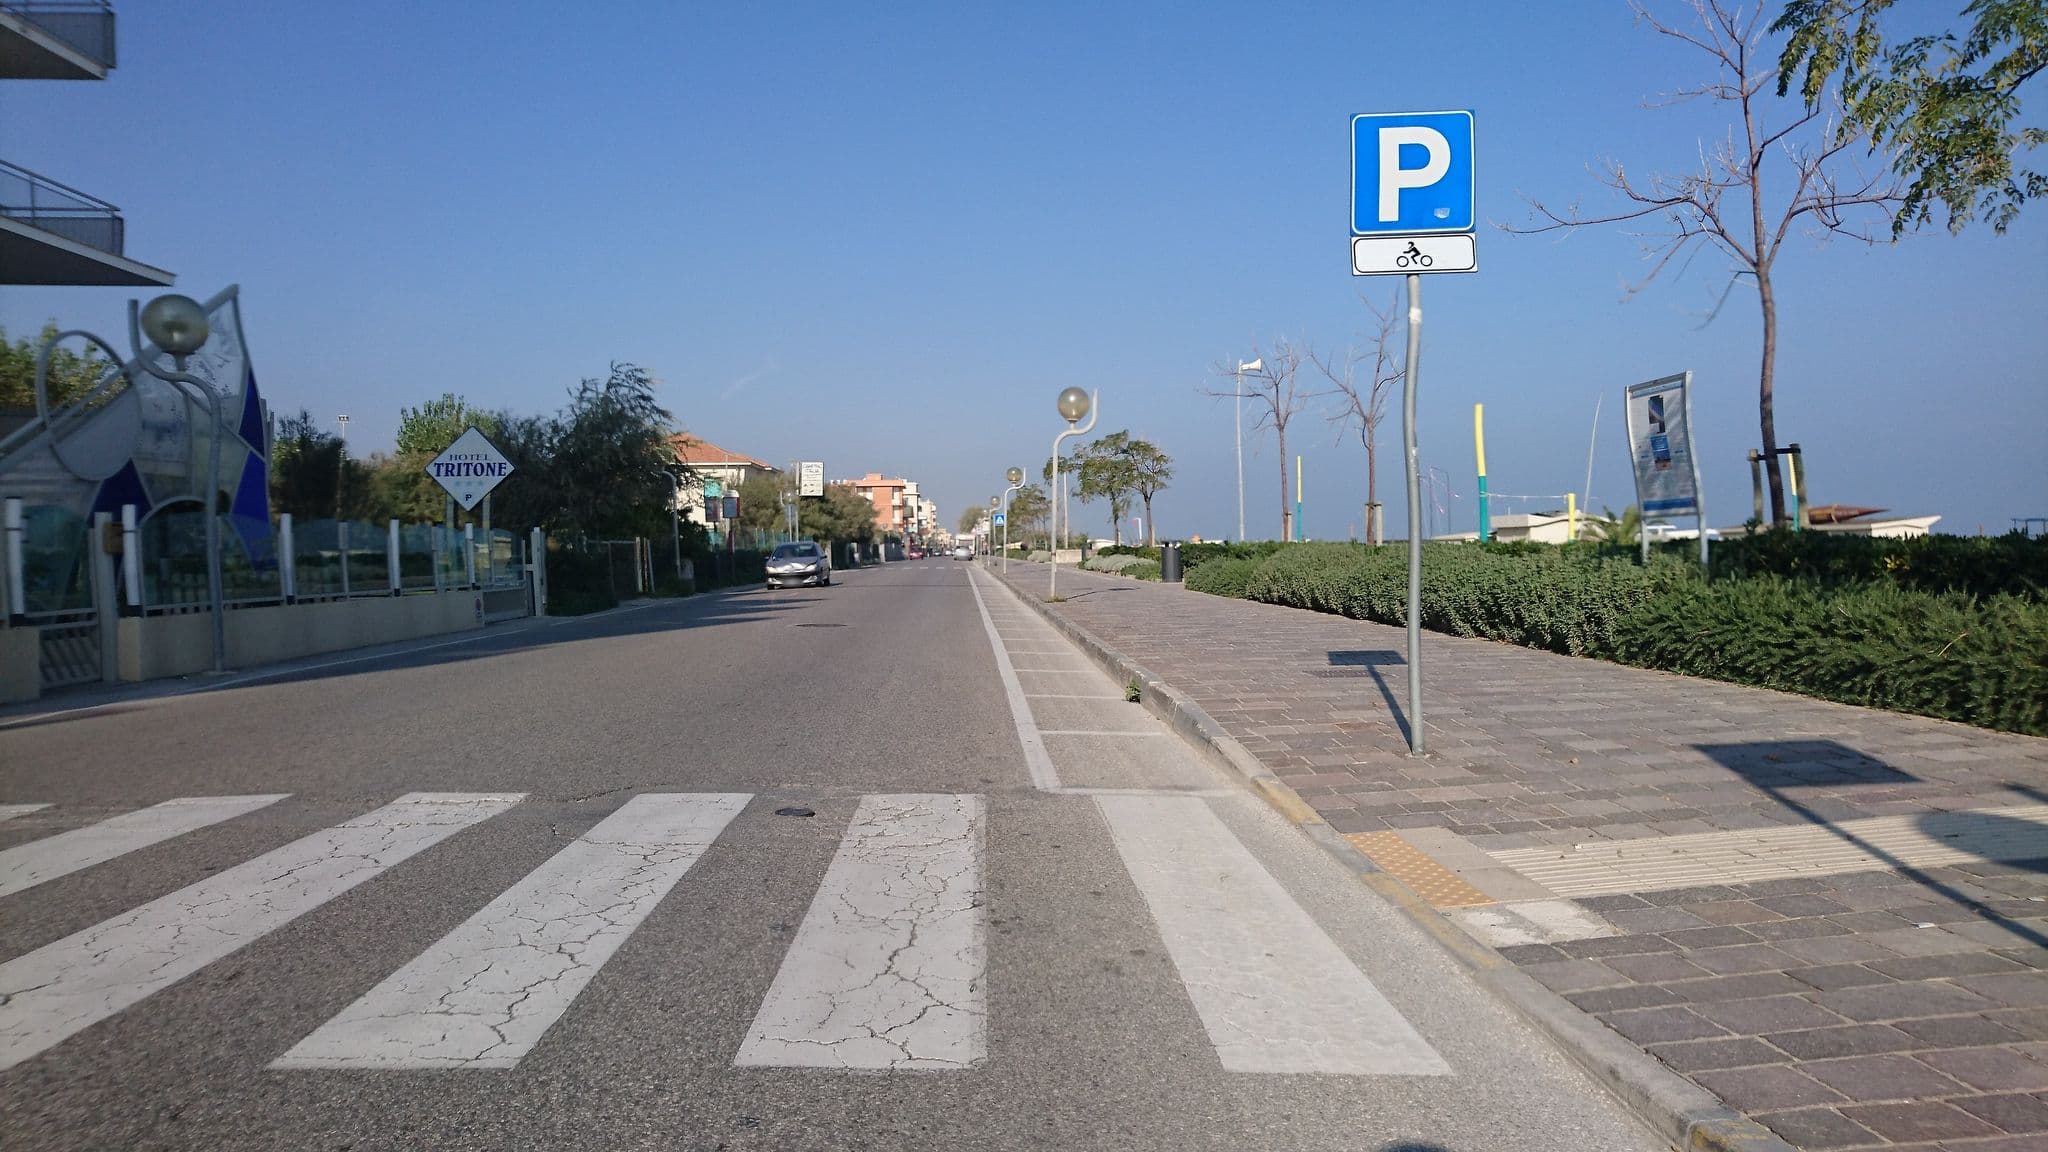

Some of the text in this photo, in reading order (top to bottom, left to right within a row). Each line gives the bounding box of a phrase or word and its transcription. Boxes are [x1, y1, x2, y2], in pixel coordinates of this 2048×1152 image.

[1378, 126, 1451, 222] P
[449, 453, 488, 461] HOTEL
[434, 462, 507, 477] TRITONE
[465, 493, 472, 501] P
